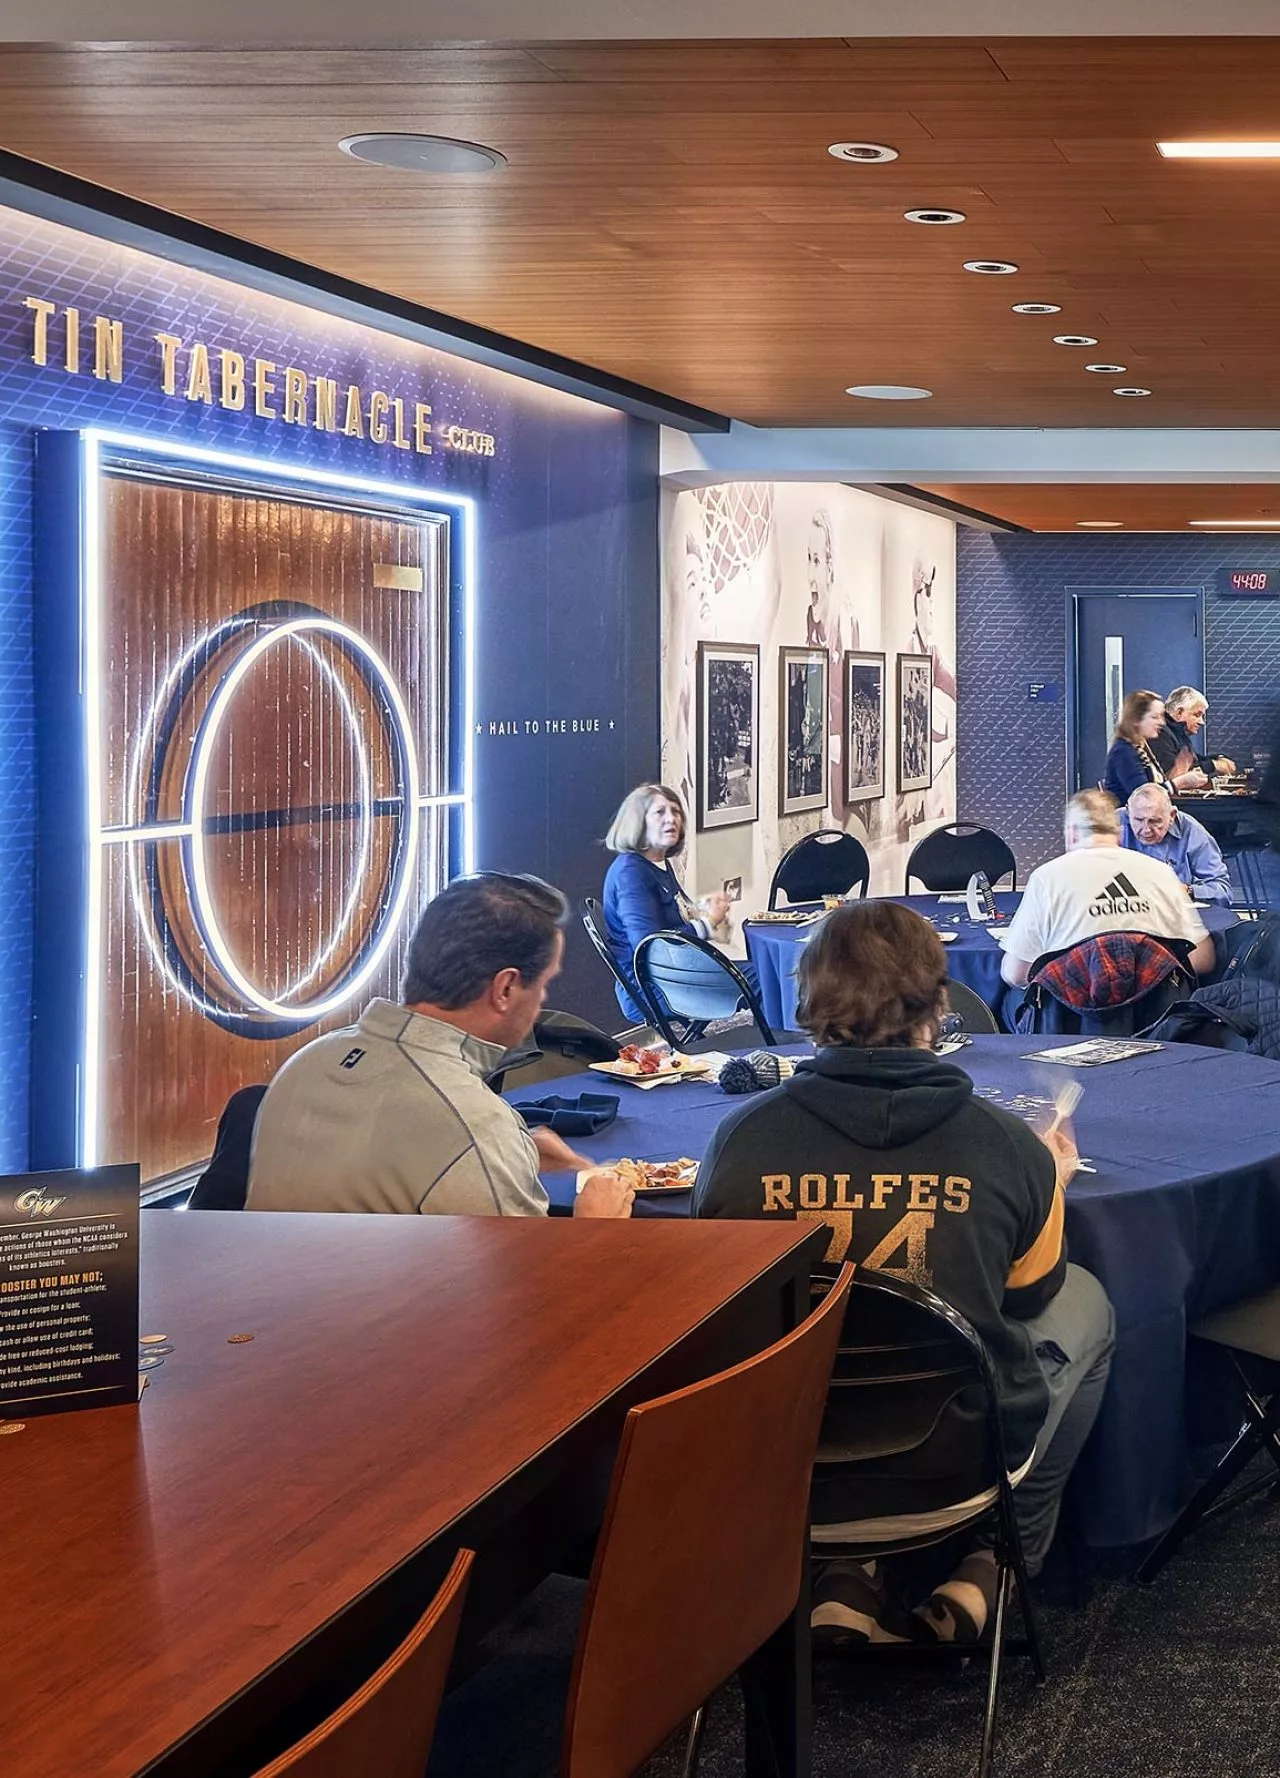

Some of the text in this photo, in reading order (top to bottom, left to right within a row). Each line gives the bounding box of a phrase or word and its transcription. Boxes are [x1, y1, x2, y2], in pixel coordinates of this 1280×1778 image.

[23, 296, 433, 454] TIN TABERNACLE
[444, 426, 496, 456] CLUB
[490, 718, 600, 736] HAIL TO THE BLUE
[1088, 897, 1151, 918] adidas
[761, 1173, 972, 1214] ROLFES
[39, 1276, 58, 1289] YOU
[60, 1273, 80, 1287] MAY
